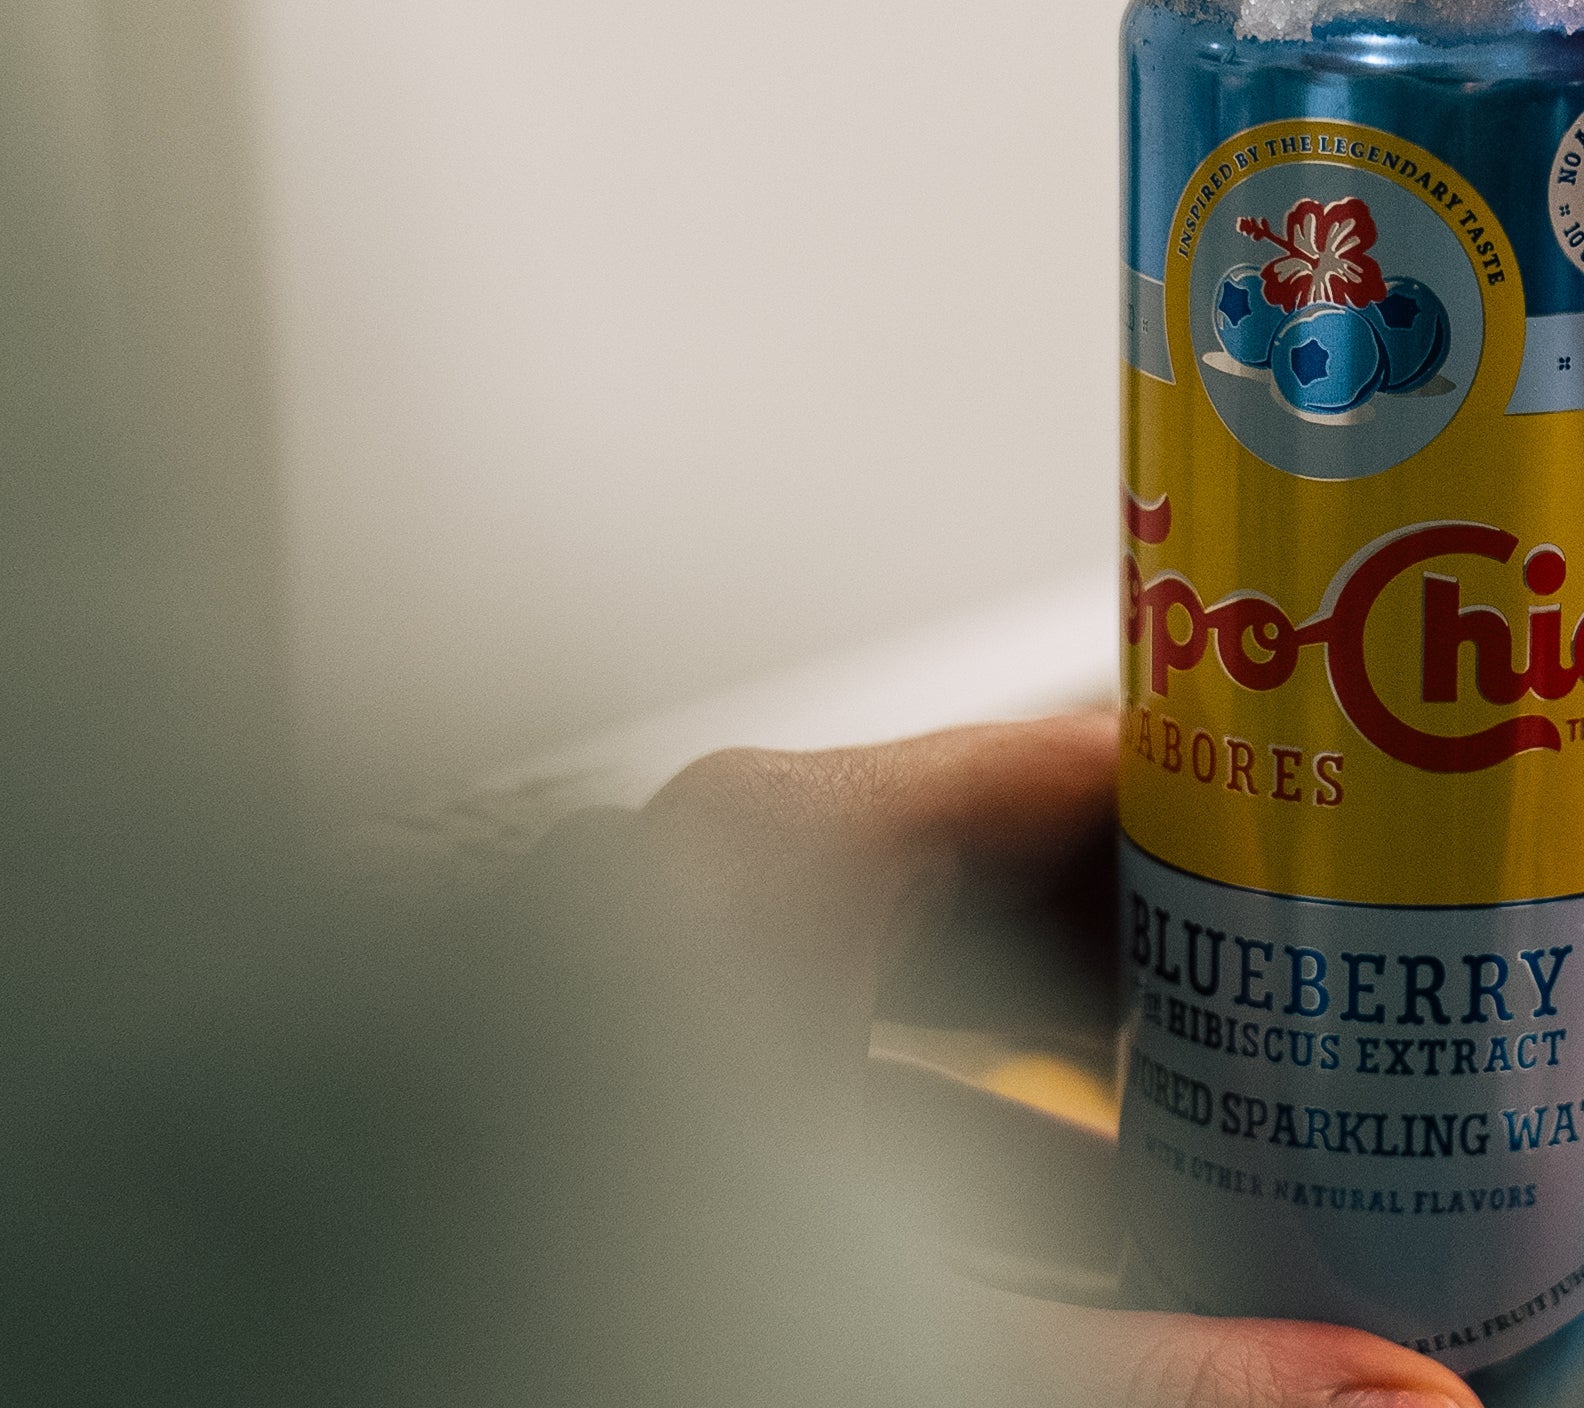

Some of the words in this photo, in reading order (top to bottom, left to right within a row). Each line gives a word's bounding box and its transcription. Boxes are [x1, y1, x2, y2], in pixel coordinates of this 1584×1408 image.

[1558, 152, 1581, 186] NO
[1177, 162, 1233, 259] INSPIRED
[1234, 144, 1261, 172] BY
[1265, 135, 1313, 159] THE
[1319, 135, 1463, 212] LEGENDARY
[1459, 208, 1506, 288] TASTE
[1126, 704, 1344, 807] ABORES
[1131, 892, 1574, 1026] BLUEBERRY
[1168, 996, 1341, 1071] HIBISCUS
[1355, 1028, 1567, 1076] EXTRACT
[1220, 1090, 1491, 1158] SPARKLING
[1191, 1158, 1264, 1199] OTHER
[1274, 1180, 1404, 1214] NATURAL
[1414, 1184, 1538, 1216] FLAVORS
[1482, 1293, 1547, 1337] FRUIT
